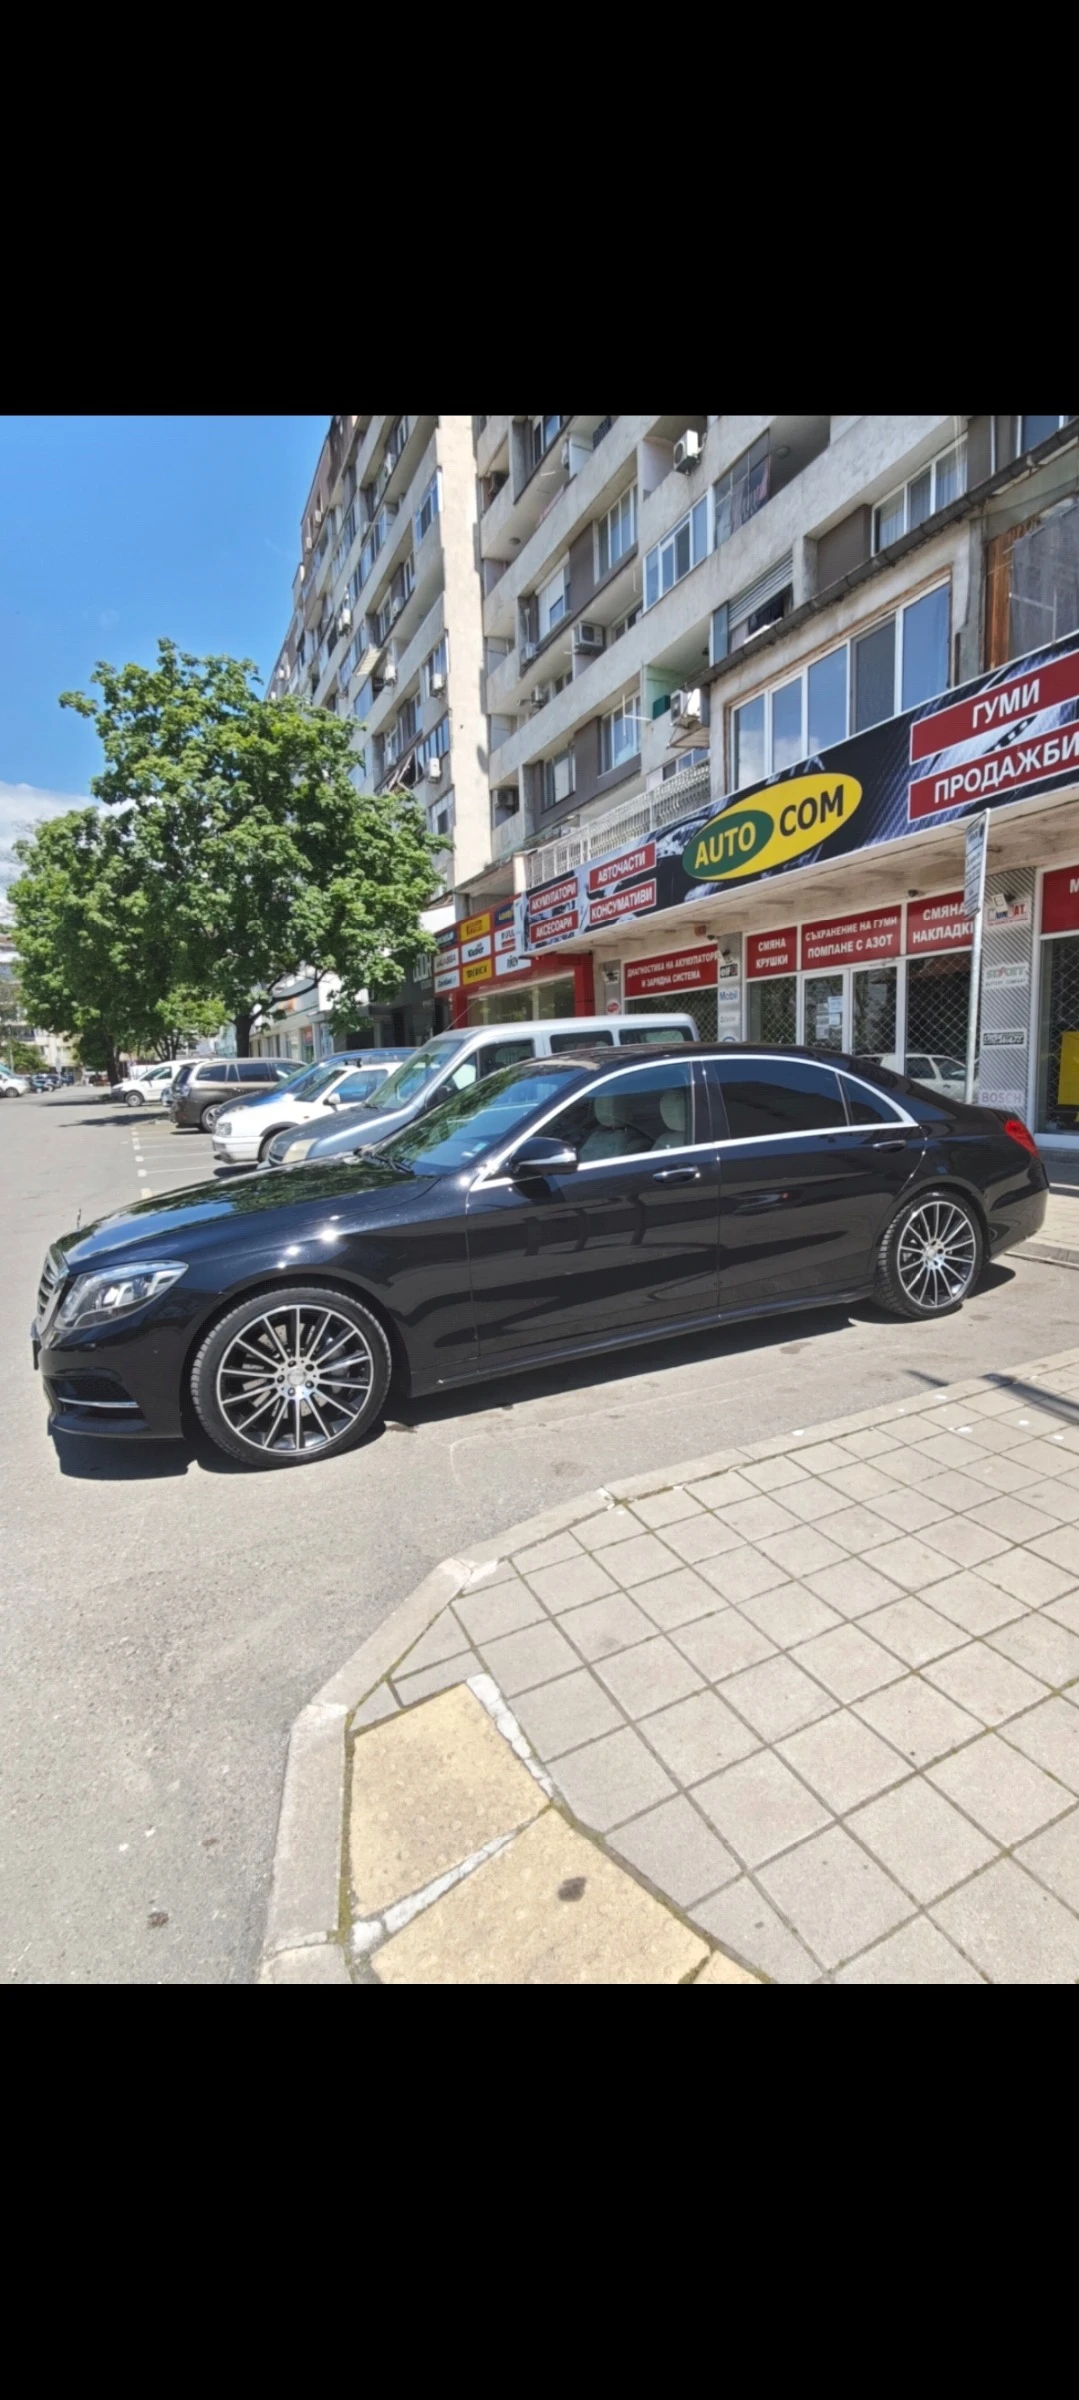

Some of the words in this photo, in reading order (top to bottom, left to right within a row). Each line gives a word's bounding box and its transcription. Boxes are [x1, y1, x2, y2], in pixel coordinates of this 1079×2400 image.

[971, 678, 1040, 729] ГУМИ
[934, 730, 1079, 804] ПРОДАЖБИ
[694, 821, 757, 870] AUTO
[779, 784, 845, 838] COM
[597, 851, 646, 884] АВТОЧАСТИ
[591, 887, 653, 921] КОНСУМАТИВИ
[535, 916, 573, 939] АКСЕСОАРИ
[805, 922, 858, 942] СЪХРАНЕНИЕ
[860, 920, 872, 931] НА
[873, 916, 898, 929] ГУМИ
[758, 938, 787, 952] СМЯНА
[807, 940, 854, 959] ПОМПАНЕ
[856, 940, 863, 951] С
[865, 934, 894, 950] АЗОТ
[627, 962, 665, 979] ДИАГНОСТИКА
[665, 960, 674, 971] НА
[756, 954, 789, 969] КРУШКИ
[672, 970, 701, 983] СИСТЕМА
[982, 1091, 1022, 1103] BOSCH
